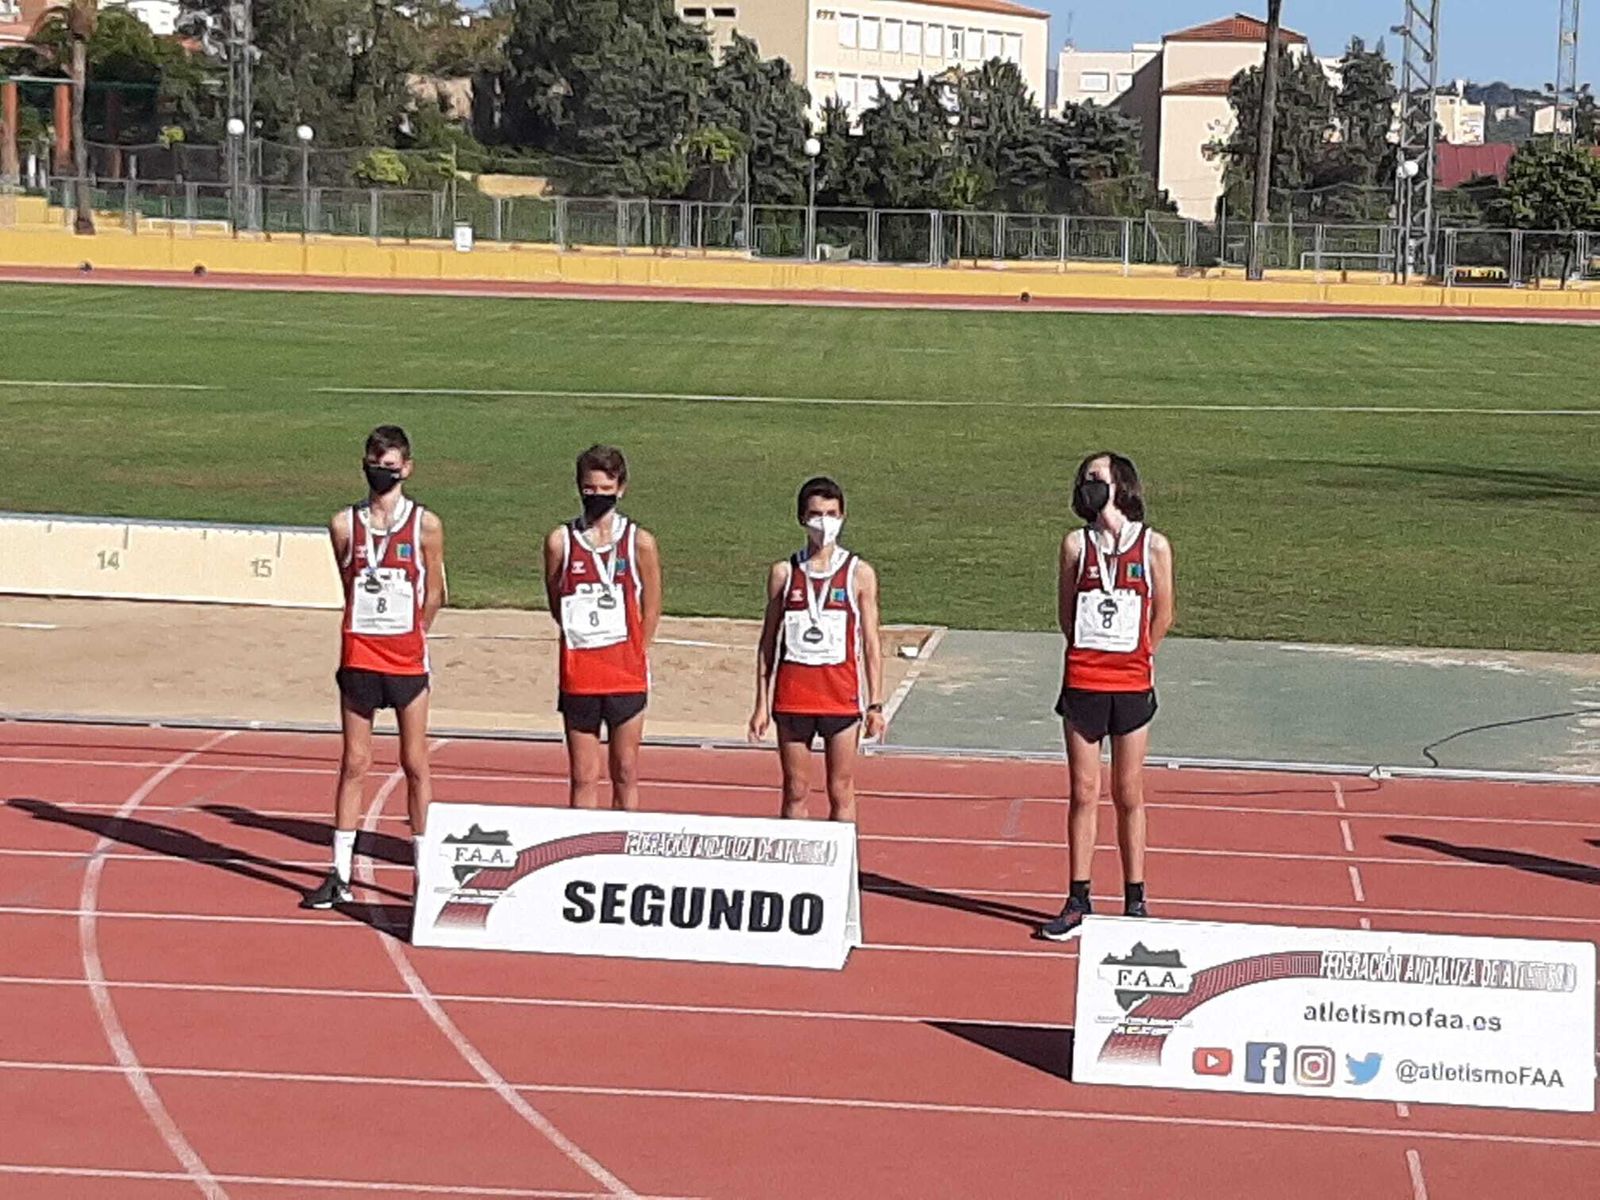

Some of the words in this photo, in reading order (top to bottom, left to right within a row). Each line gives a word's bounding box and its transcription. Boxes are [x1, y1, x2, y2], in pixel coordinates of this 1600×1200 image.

[97, 551, 120, 570] 14
[251, 558, 273, 578] 15
[377, 597, 387, 613] 8
[1102, 613, 1112, 629] 8
[562, 880, 824, 935] SEGUNDO
[1320, 945, 1402, 983] FEDERACIÓN
[1403, 954, 1477, 987] ANDALUZA
[1481, 959, 1500, 988] DE
[1303, 1002, 1502, 1033] atletismofaa.es
[1396, 1058, 1564, 1088] @atletismoFAA
